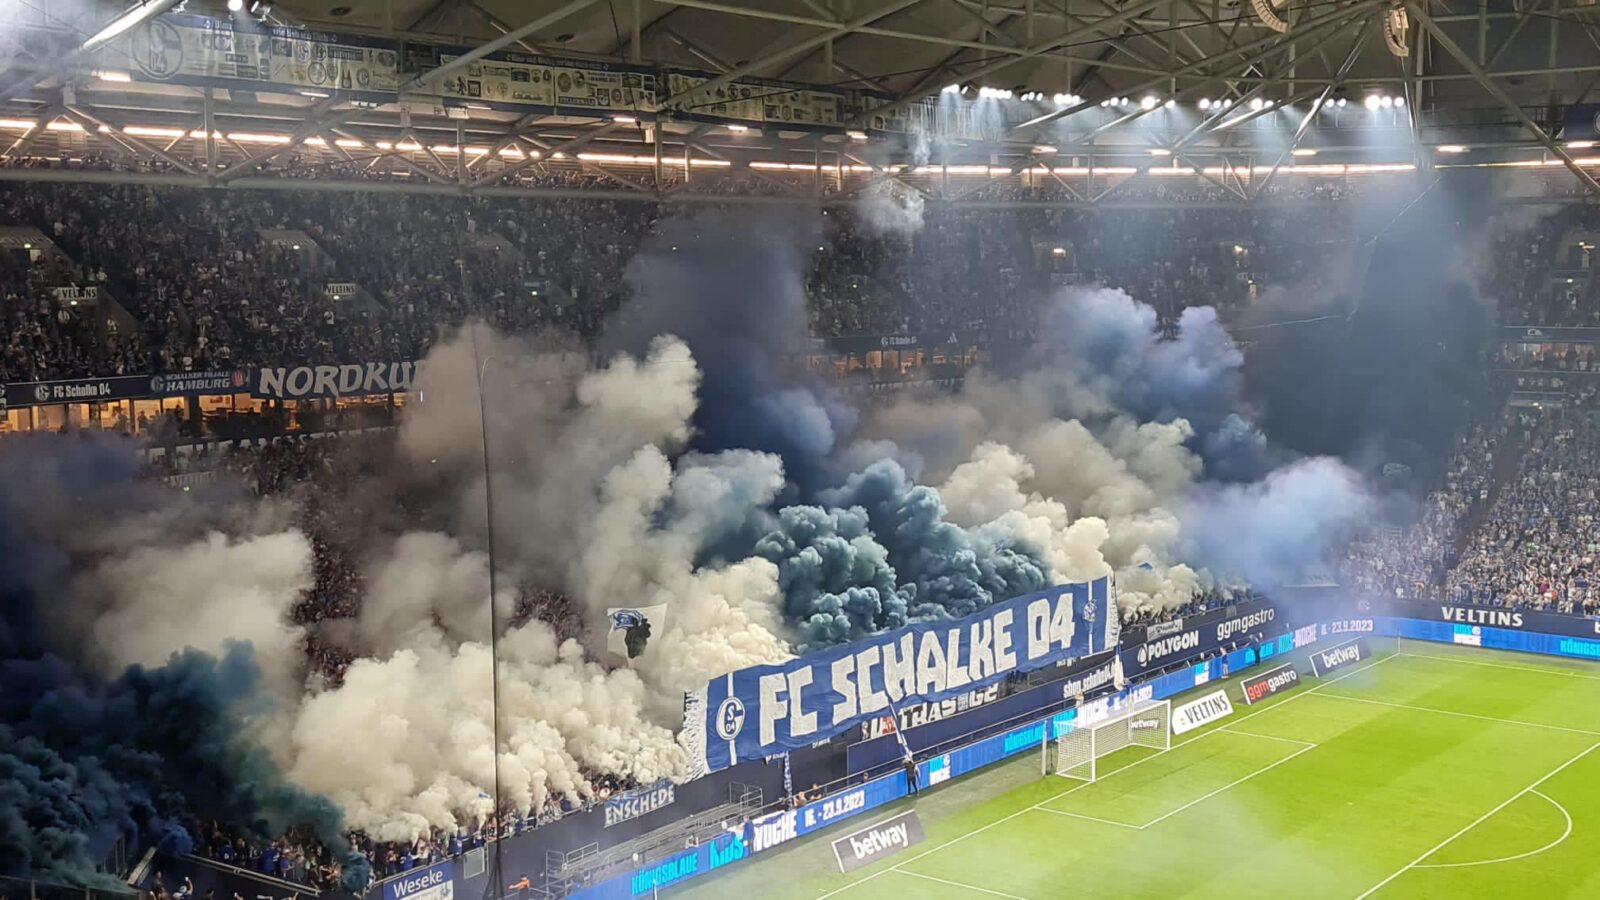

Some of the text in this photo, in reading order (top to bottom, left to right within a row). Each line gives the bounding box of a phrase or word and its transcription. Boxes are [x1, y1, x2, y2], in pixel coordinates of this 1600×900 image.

[62, 289, 97, 298] VELTNS
[53, 385, 65, 398] FC
[99, 382, 111, 395] 04
[166, 379, 230, 392] HAMBURG
[259, 361, 420, 398] NORDKU
[1217, 608, 1275, 641] ggmgastro
[1441, 606, 1524, 628] VELTINS
[1148, 630, 1200, 662] POLYGON
[1321, 644, 1361, 668] betway
[760, 593, 1076, 747] FC SCHALKE 04
[1247, 670, 1297, 699] ggmgastro
[1184, 694, 1228, 724] VELTINS
[604, 785, 675, 827] ENSCHEDE
[823, 790, 865, 821] 23.9.2023
[850, 822, 908, 859] betway
[393, 869, 443, 898] Weseke
